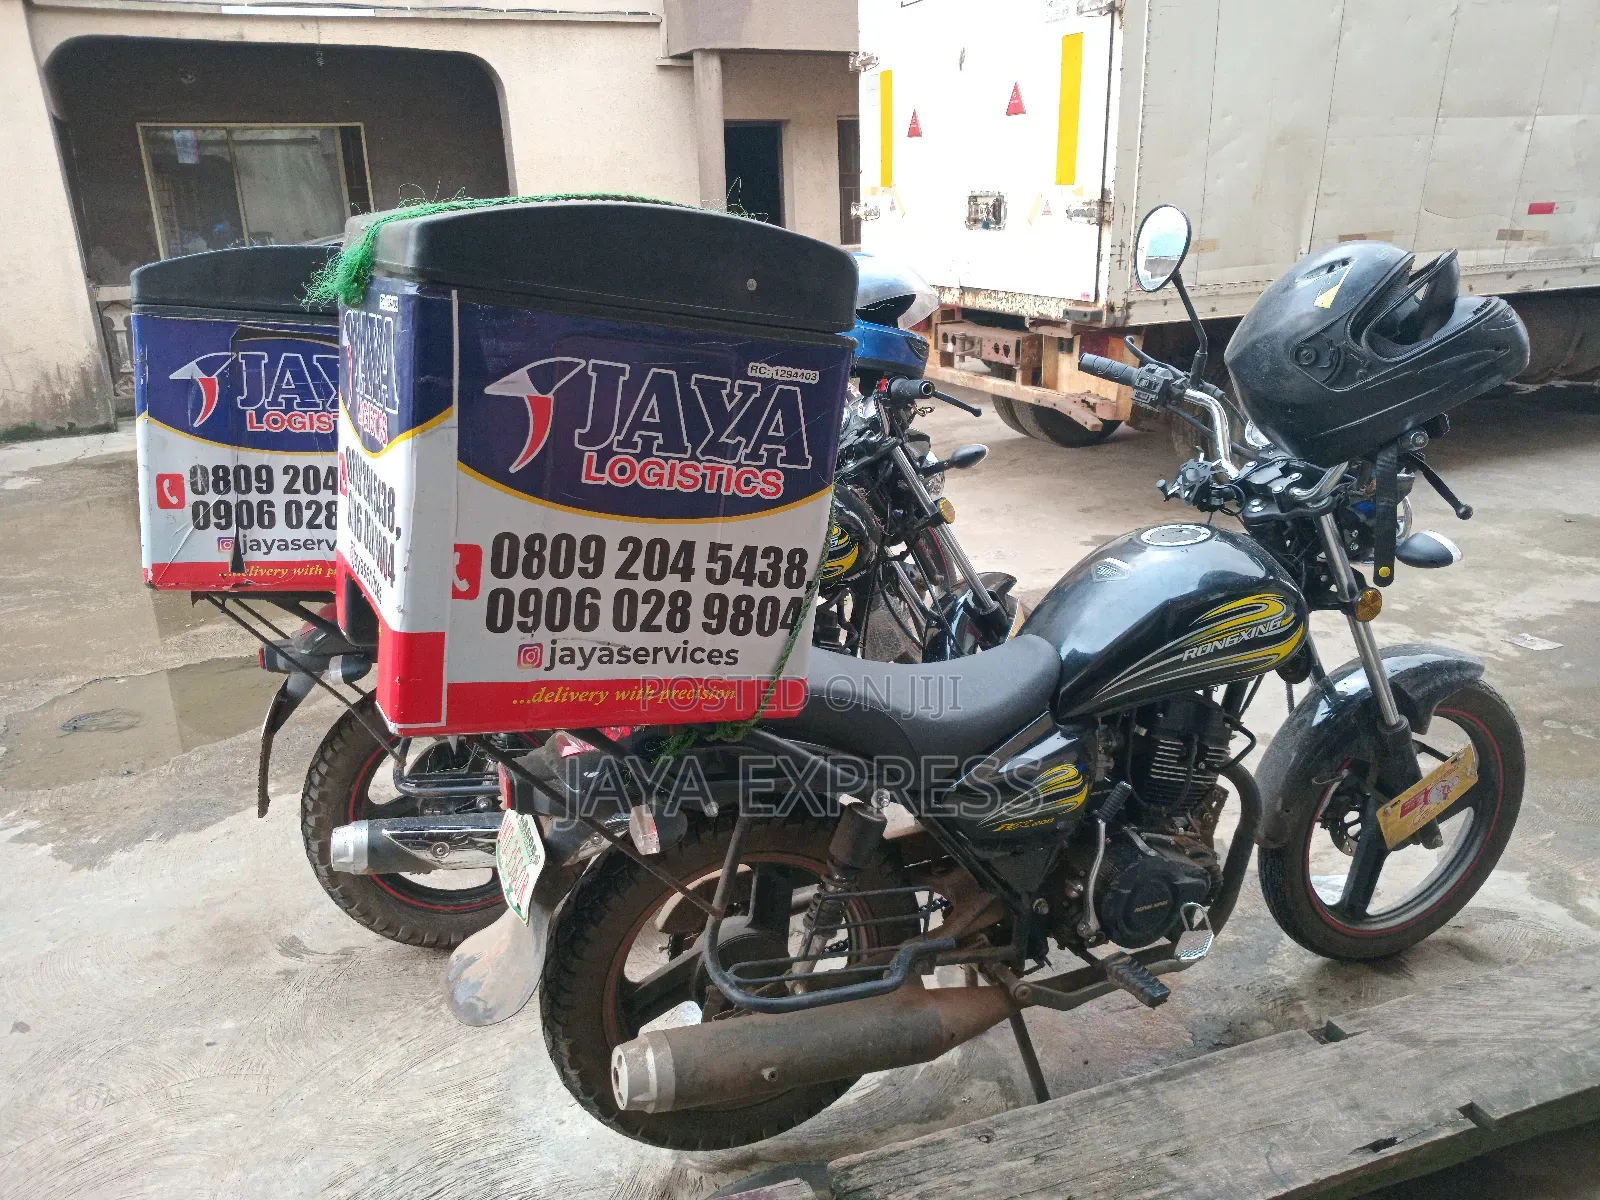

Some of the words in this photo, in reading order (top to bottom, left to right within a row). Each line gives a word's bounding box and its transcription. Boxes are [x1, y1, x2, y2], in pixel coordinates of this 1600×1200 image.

[750, 364, 771, 376] RC:
[774, 368, 818, 381] 1294403
[575, 359, 812, 469] JAYA
[190, 464, 275, 495] 0809
[283, 465, 338, 495] 204
[582, 452, 784, 499] LOGISTICS
[192, 500, 276, 530] 0906
[285, 500, 337, 530] 028
[292, 564, 323, 577] with
[491, 532, 606, 580] 0809
[615, 536, 696, 582] 204
[486, 587, 602, 633] 0906
[612, 588, 692, 633] 028
[702, 593, 804, 637] 9804
[544, 639, 739, 671] jayaservices
[1182, 617, 1283, 661] RONGXING
[615, 685, 655, 700] with
[657, 685, 736, 704] precision
